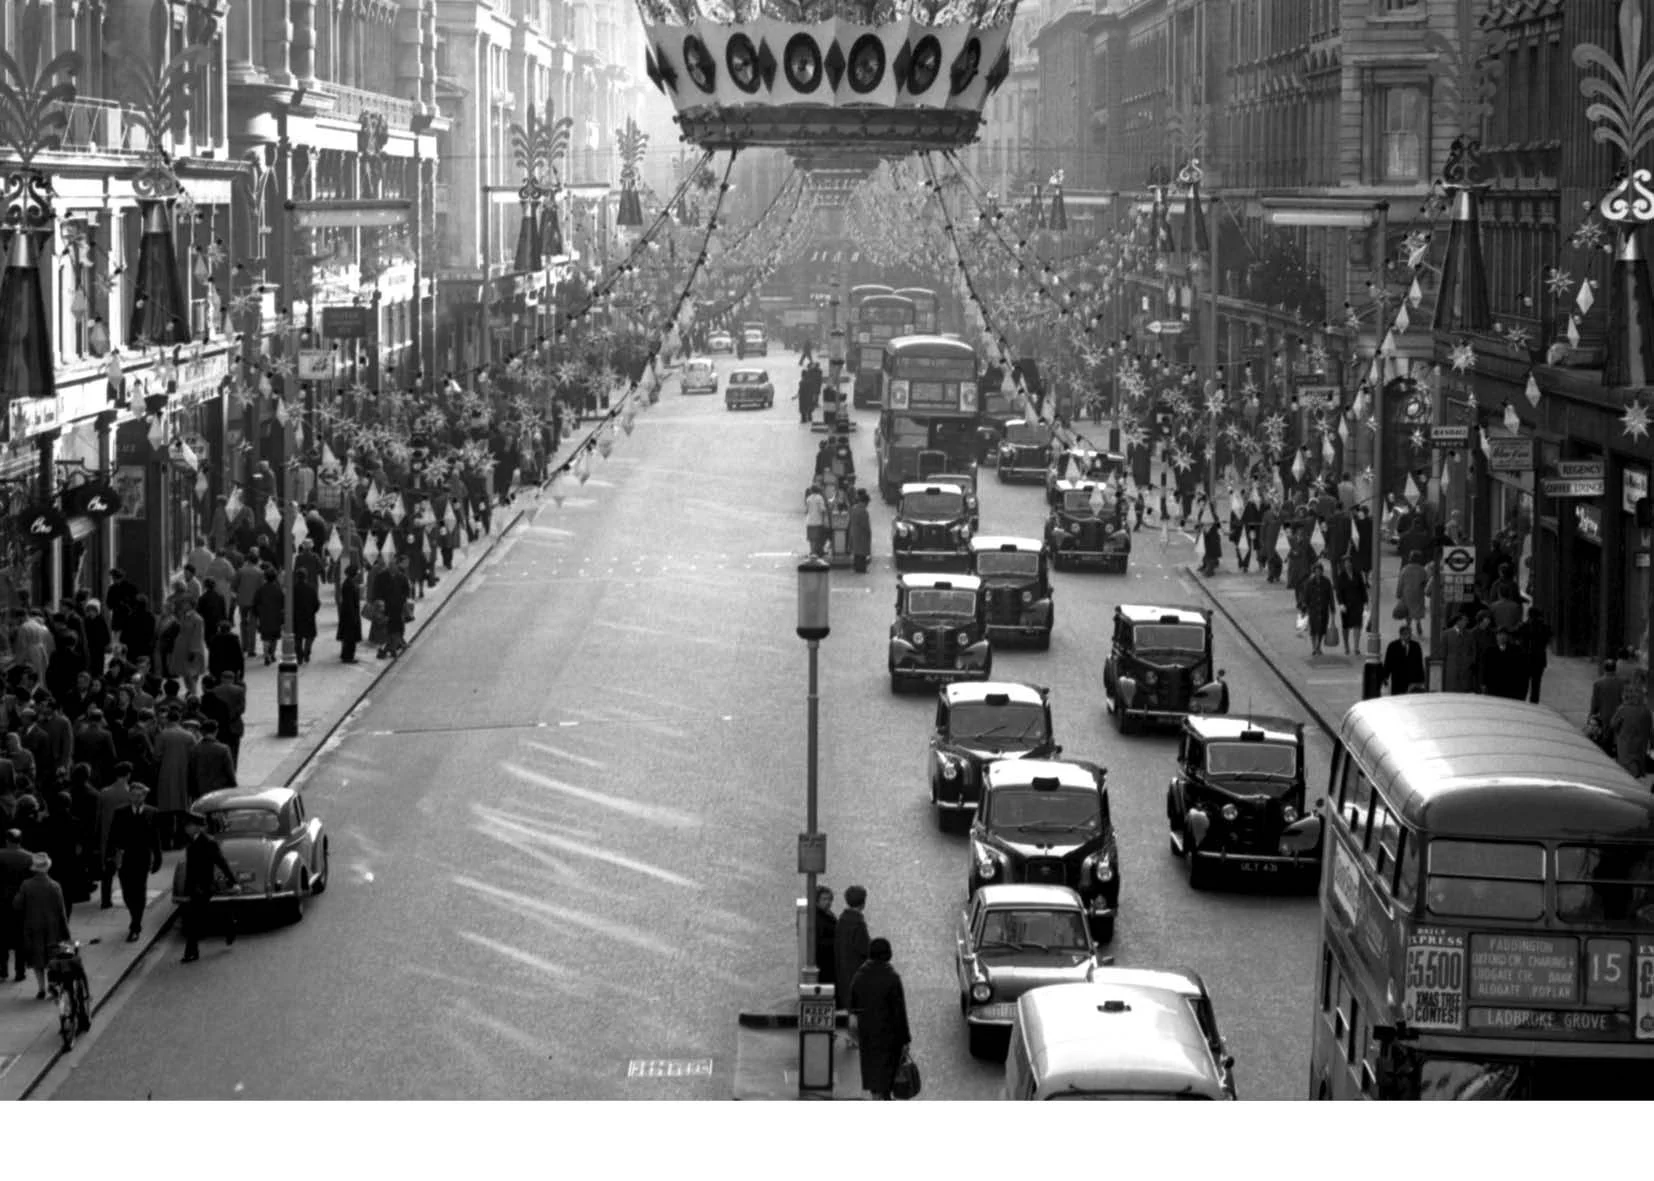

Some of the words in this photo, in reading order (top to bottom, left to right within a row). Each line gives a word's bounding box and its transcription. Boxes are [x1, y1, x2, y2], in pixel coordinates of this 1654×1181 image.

[1563, 464, 1601, 475] REGENCY
[1417, 928, 1447, 936] DAILY
[1407, 936, 1464, 946] XPRESS
[1489, 938, 1554, 953] PADDINGTON
[1592, 953, 1622, 983] 15
[1531, 985, 1571, 998] POPLAR
[1416, 992, 1439, 1006] XMAS
[1440, 993, 1461, 1007] TREE
[805, 1007, 831, 1016] KEEP
[1415, 1006, 1460, 1024] CONTEST
[805, 1016, 831, 1025] LEFT
[1487, 1009, 1554, 1026] LADBROKE
[1563, 1013, 1608, 1030] GROVE
